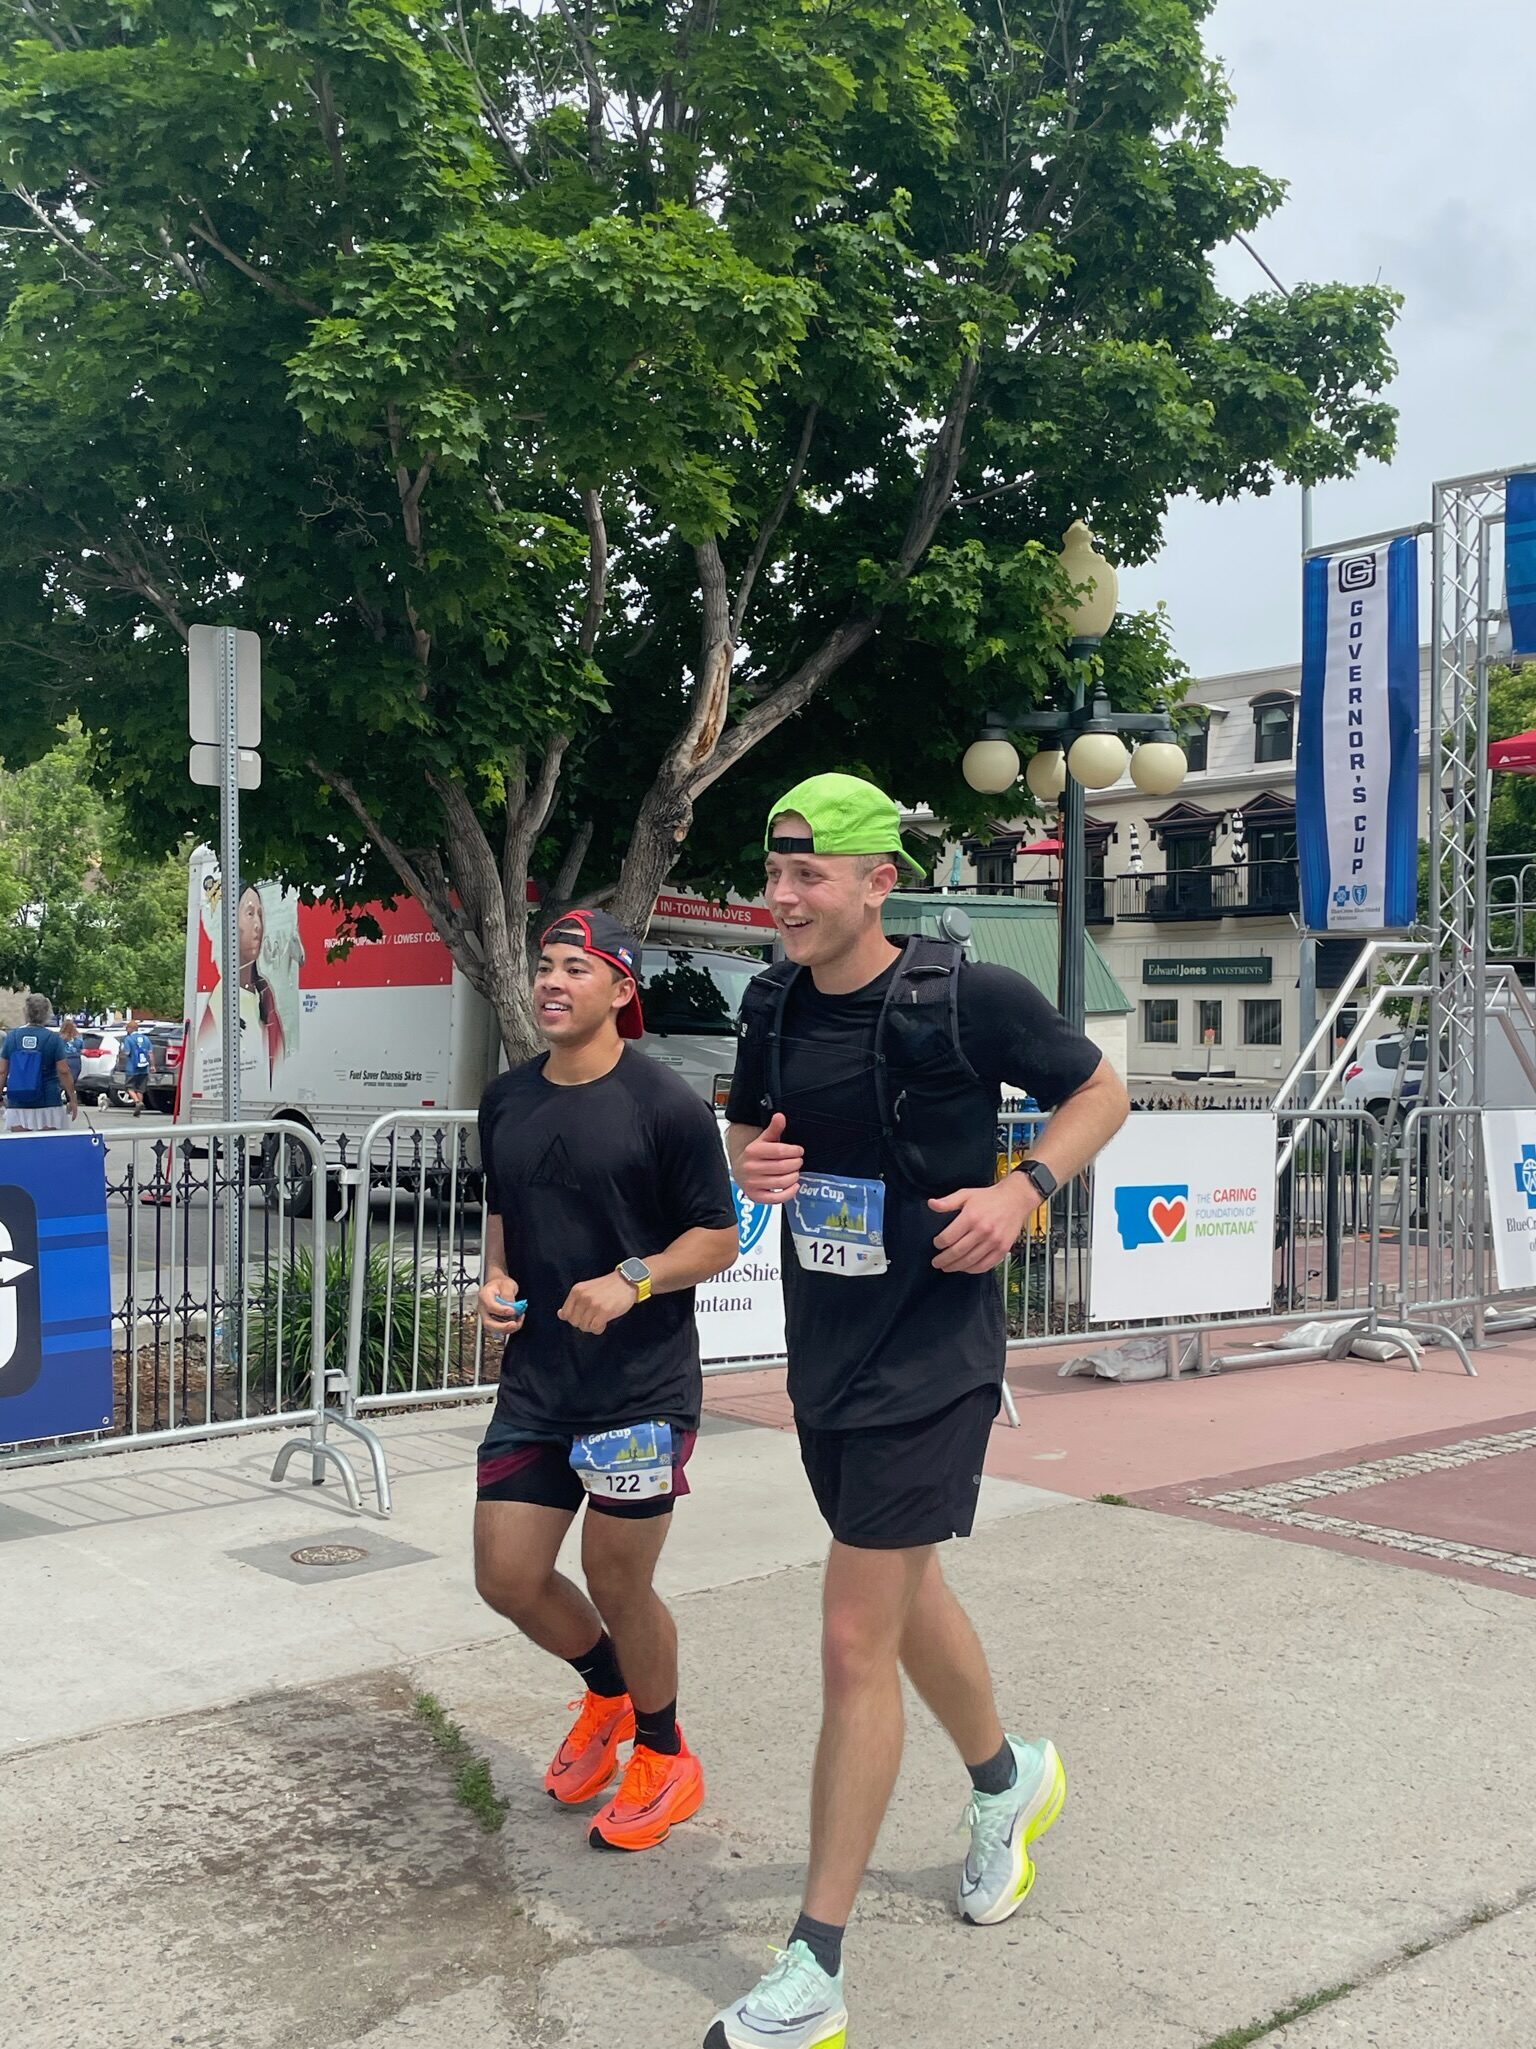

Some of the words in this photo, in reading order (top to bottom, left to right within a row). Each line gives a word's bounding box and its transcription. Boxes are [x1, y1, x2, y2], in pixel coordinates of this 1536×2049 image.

[1348, 599, 1367, 803] GOVERNOR'S
[1351, 815, 1367, 875] CUP
[660, 901, 710, 917] IN-TOWN
[712, 907, 752, 922] MOVES
[393, 932, 424, 945] LOWEST
[424, 931, 441, 943] COS
[1212, 966, 1264, 976] INVESTMENTS
[349, 1070, 362, 1080] Fuel
[362, 1070, 380, 1080] Saver
[380, 1070, 403, 1081] Chassis
[404, 1071, 423, 1081] Skirts
[799, 1183, 820, 1197] Gov
[820, 1185, 845, 1203] Cup
[1197, 1193, 1212, 1204] THE
[1213, 1187, 1257, 1203] CARING
[1196, 1207, 1245, 1219] FOUNDATION
[1246, 1206, 1257, 1217] OF
[1506, 1216, 1536, 1232] BlueCr
[809, 1241, 846, 1267] 121
[588, 1433, 608, 1445] Gov
[608, 1427, 632, 1440] Cup
[605, 1474, 641, 1493] 122
